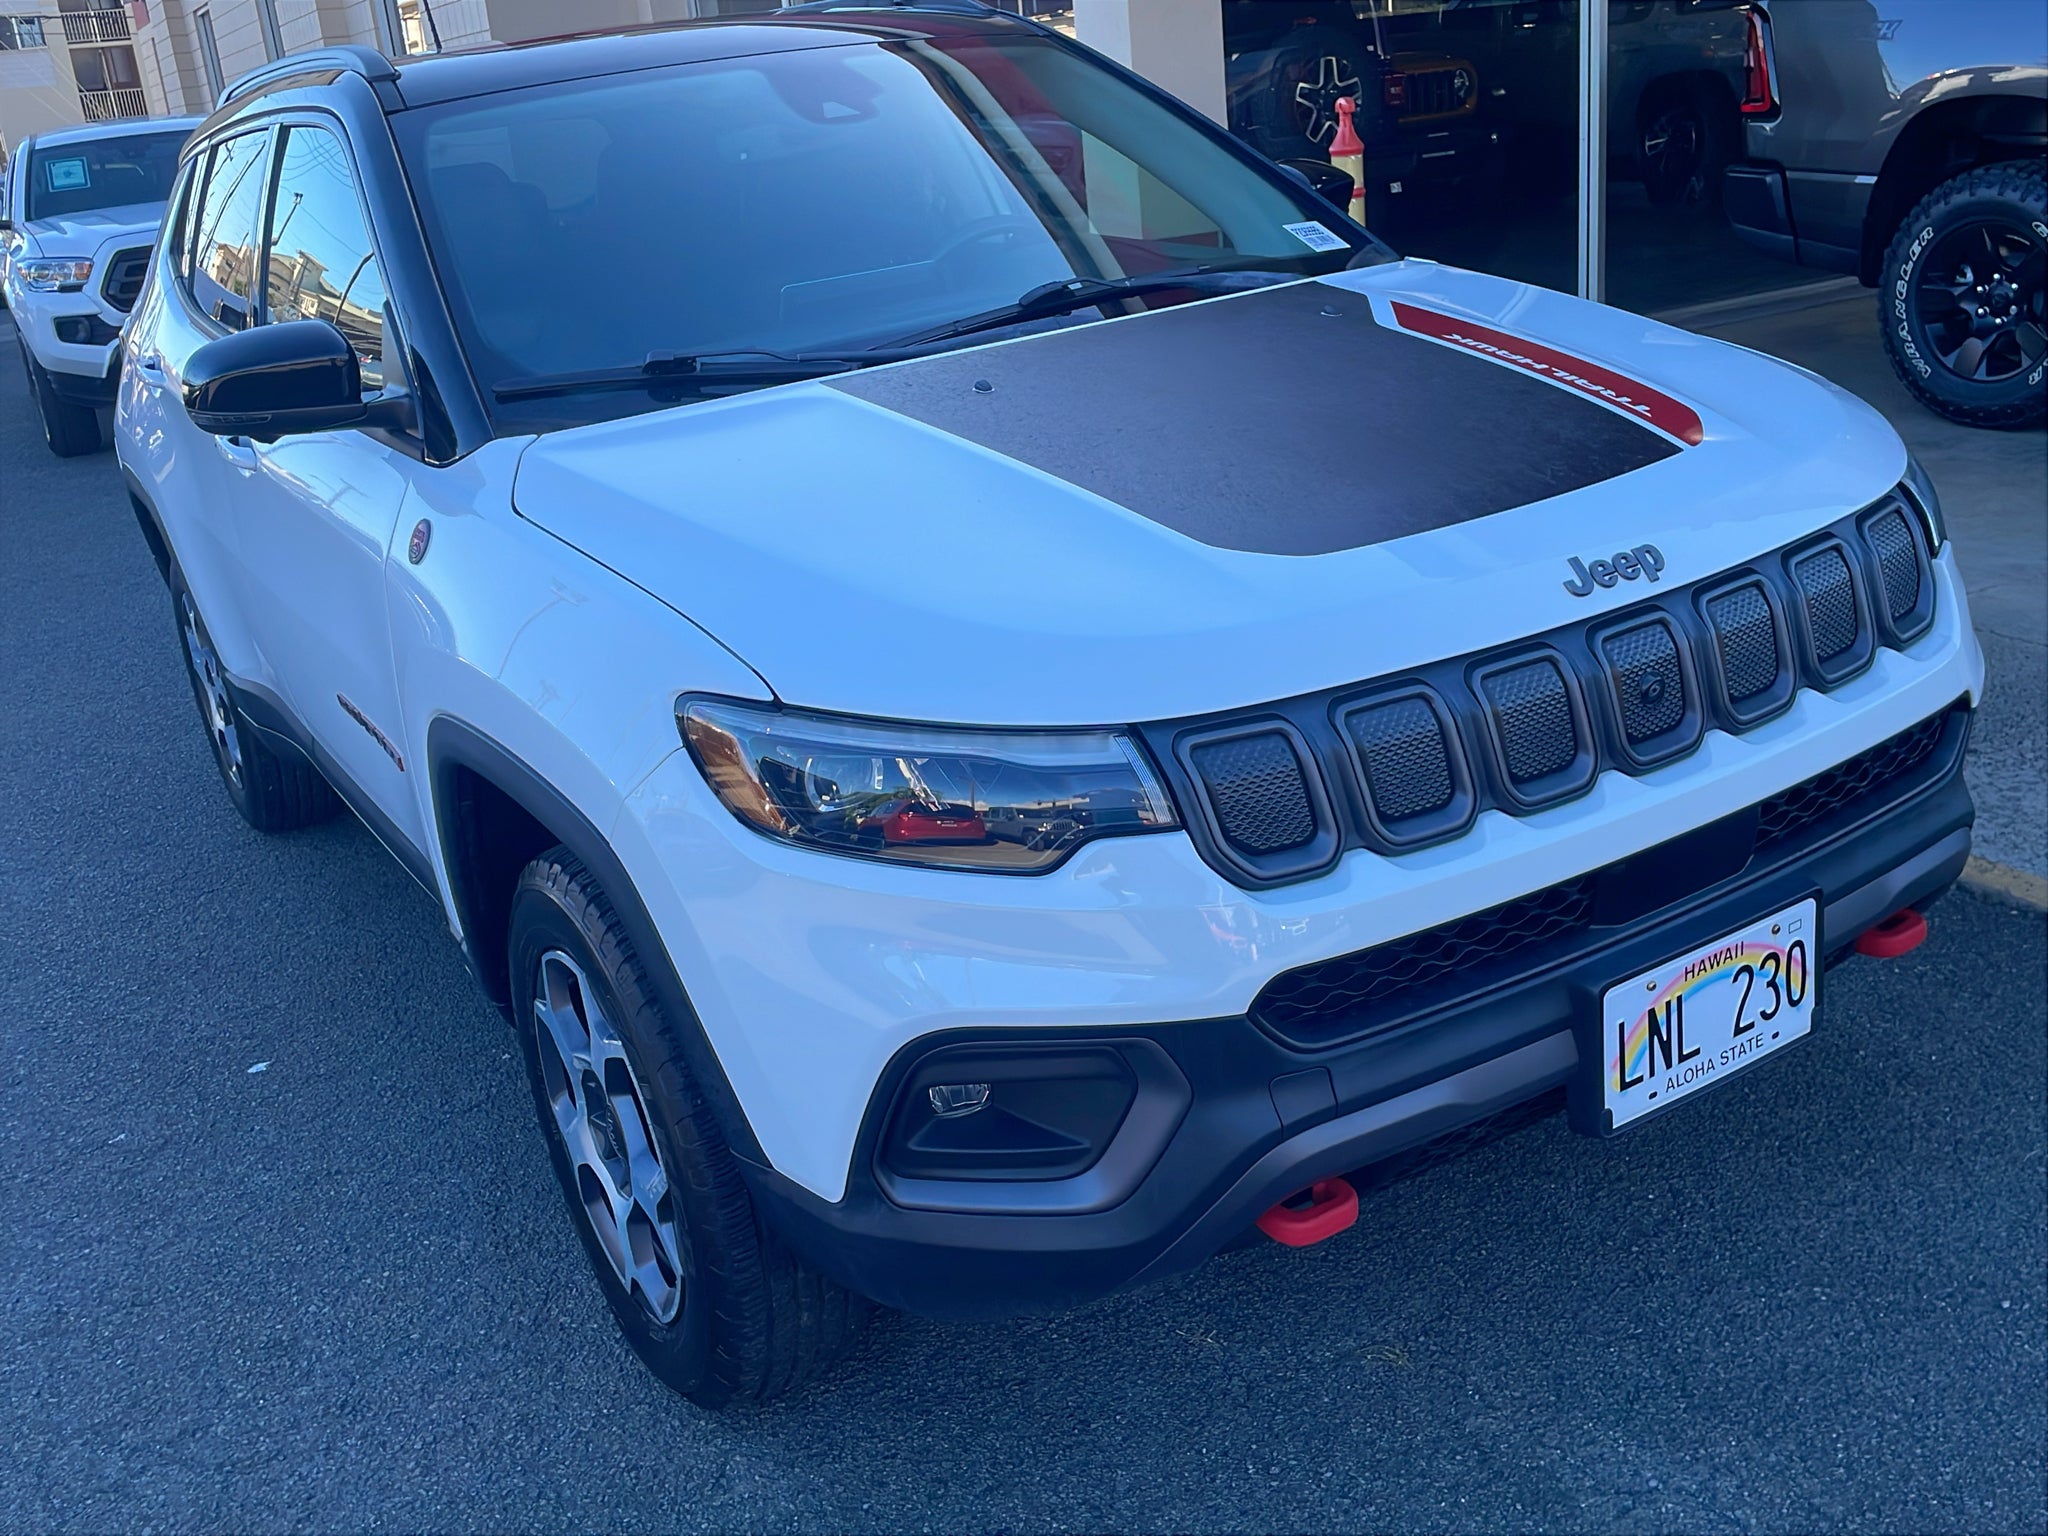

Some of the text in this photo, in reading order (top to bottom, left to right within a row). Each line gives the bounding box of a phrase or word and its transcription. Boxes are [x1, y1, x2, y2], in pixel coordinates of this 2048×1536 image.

[1895, 226, 1934, 378] WRANGLER
[1562, 543, 1666, 598] Jeep
[1684, 941, 1744, 982] HAWAII
[1618, 939, 1807, 1093] LNL 230
[1665, 1032, 1764, 1093] ALOHA STATE
